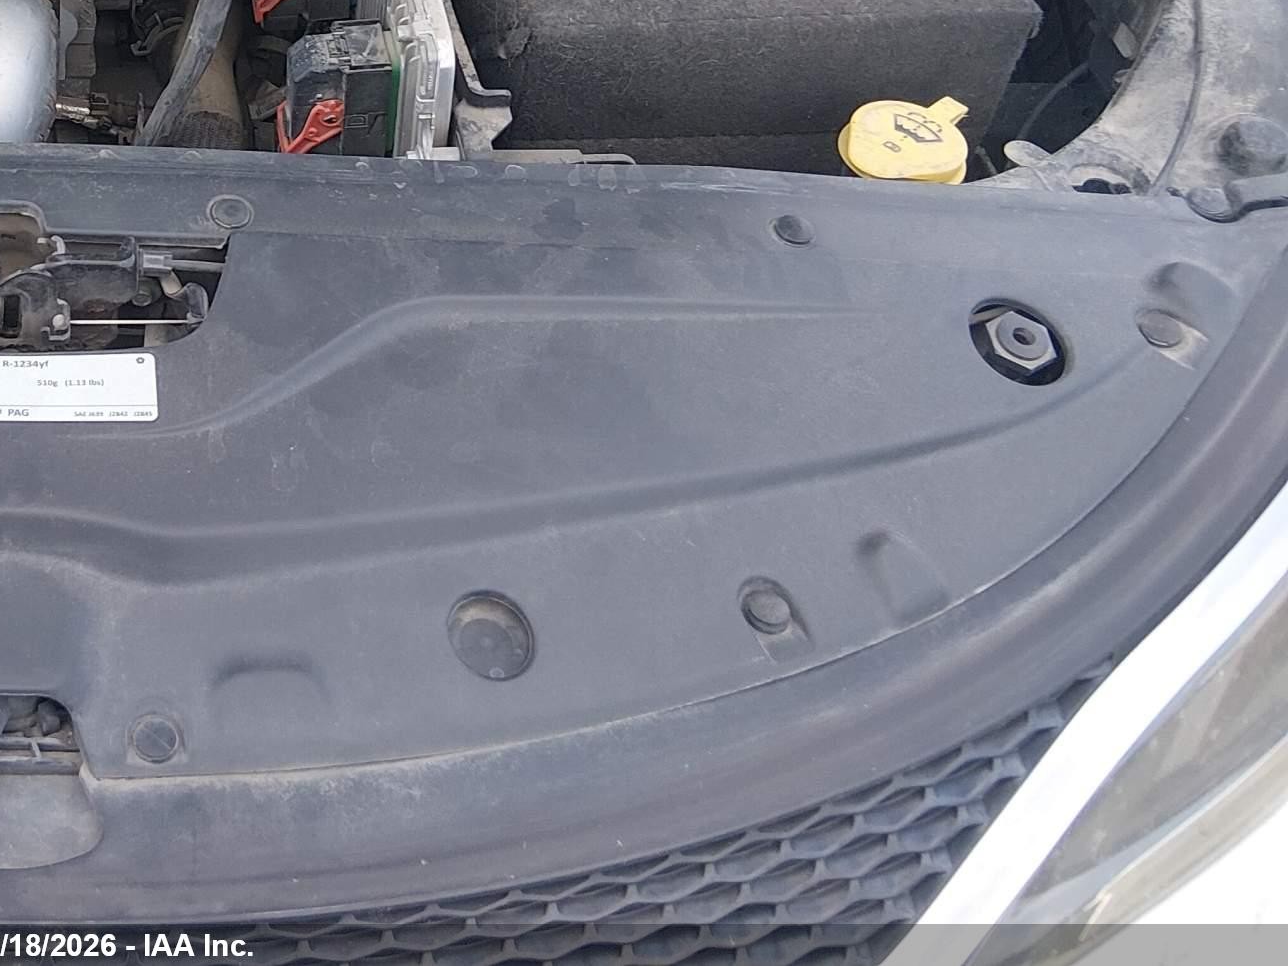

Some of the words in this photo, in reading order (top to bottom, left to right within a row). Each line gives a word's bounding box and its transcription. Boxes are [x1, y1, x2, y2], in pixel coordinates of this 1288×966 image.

[2, 360, 49, 369] R-1234yf
[36, 379, 58, 388] 510g
[7, 408, 30, 417] PAG
